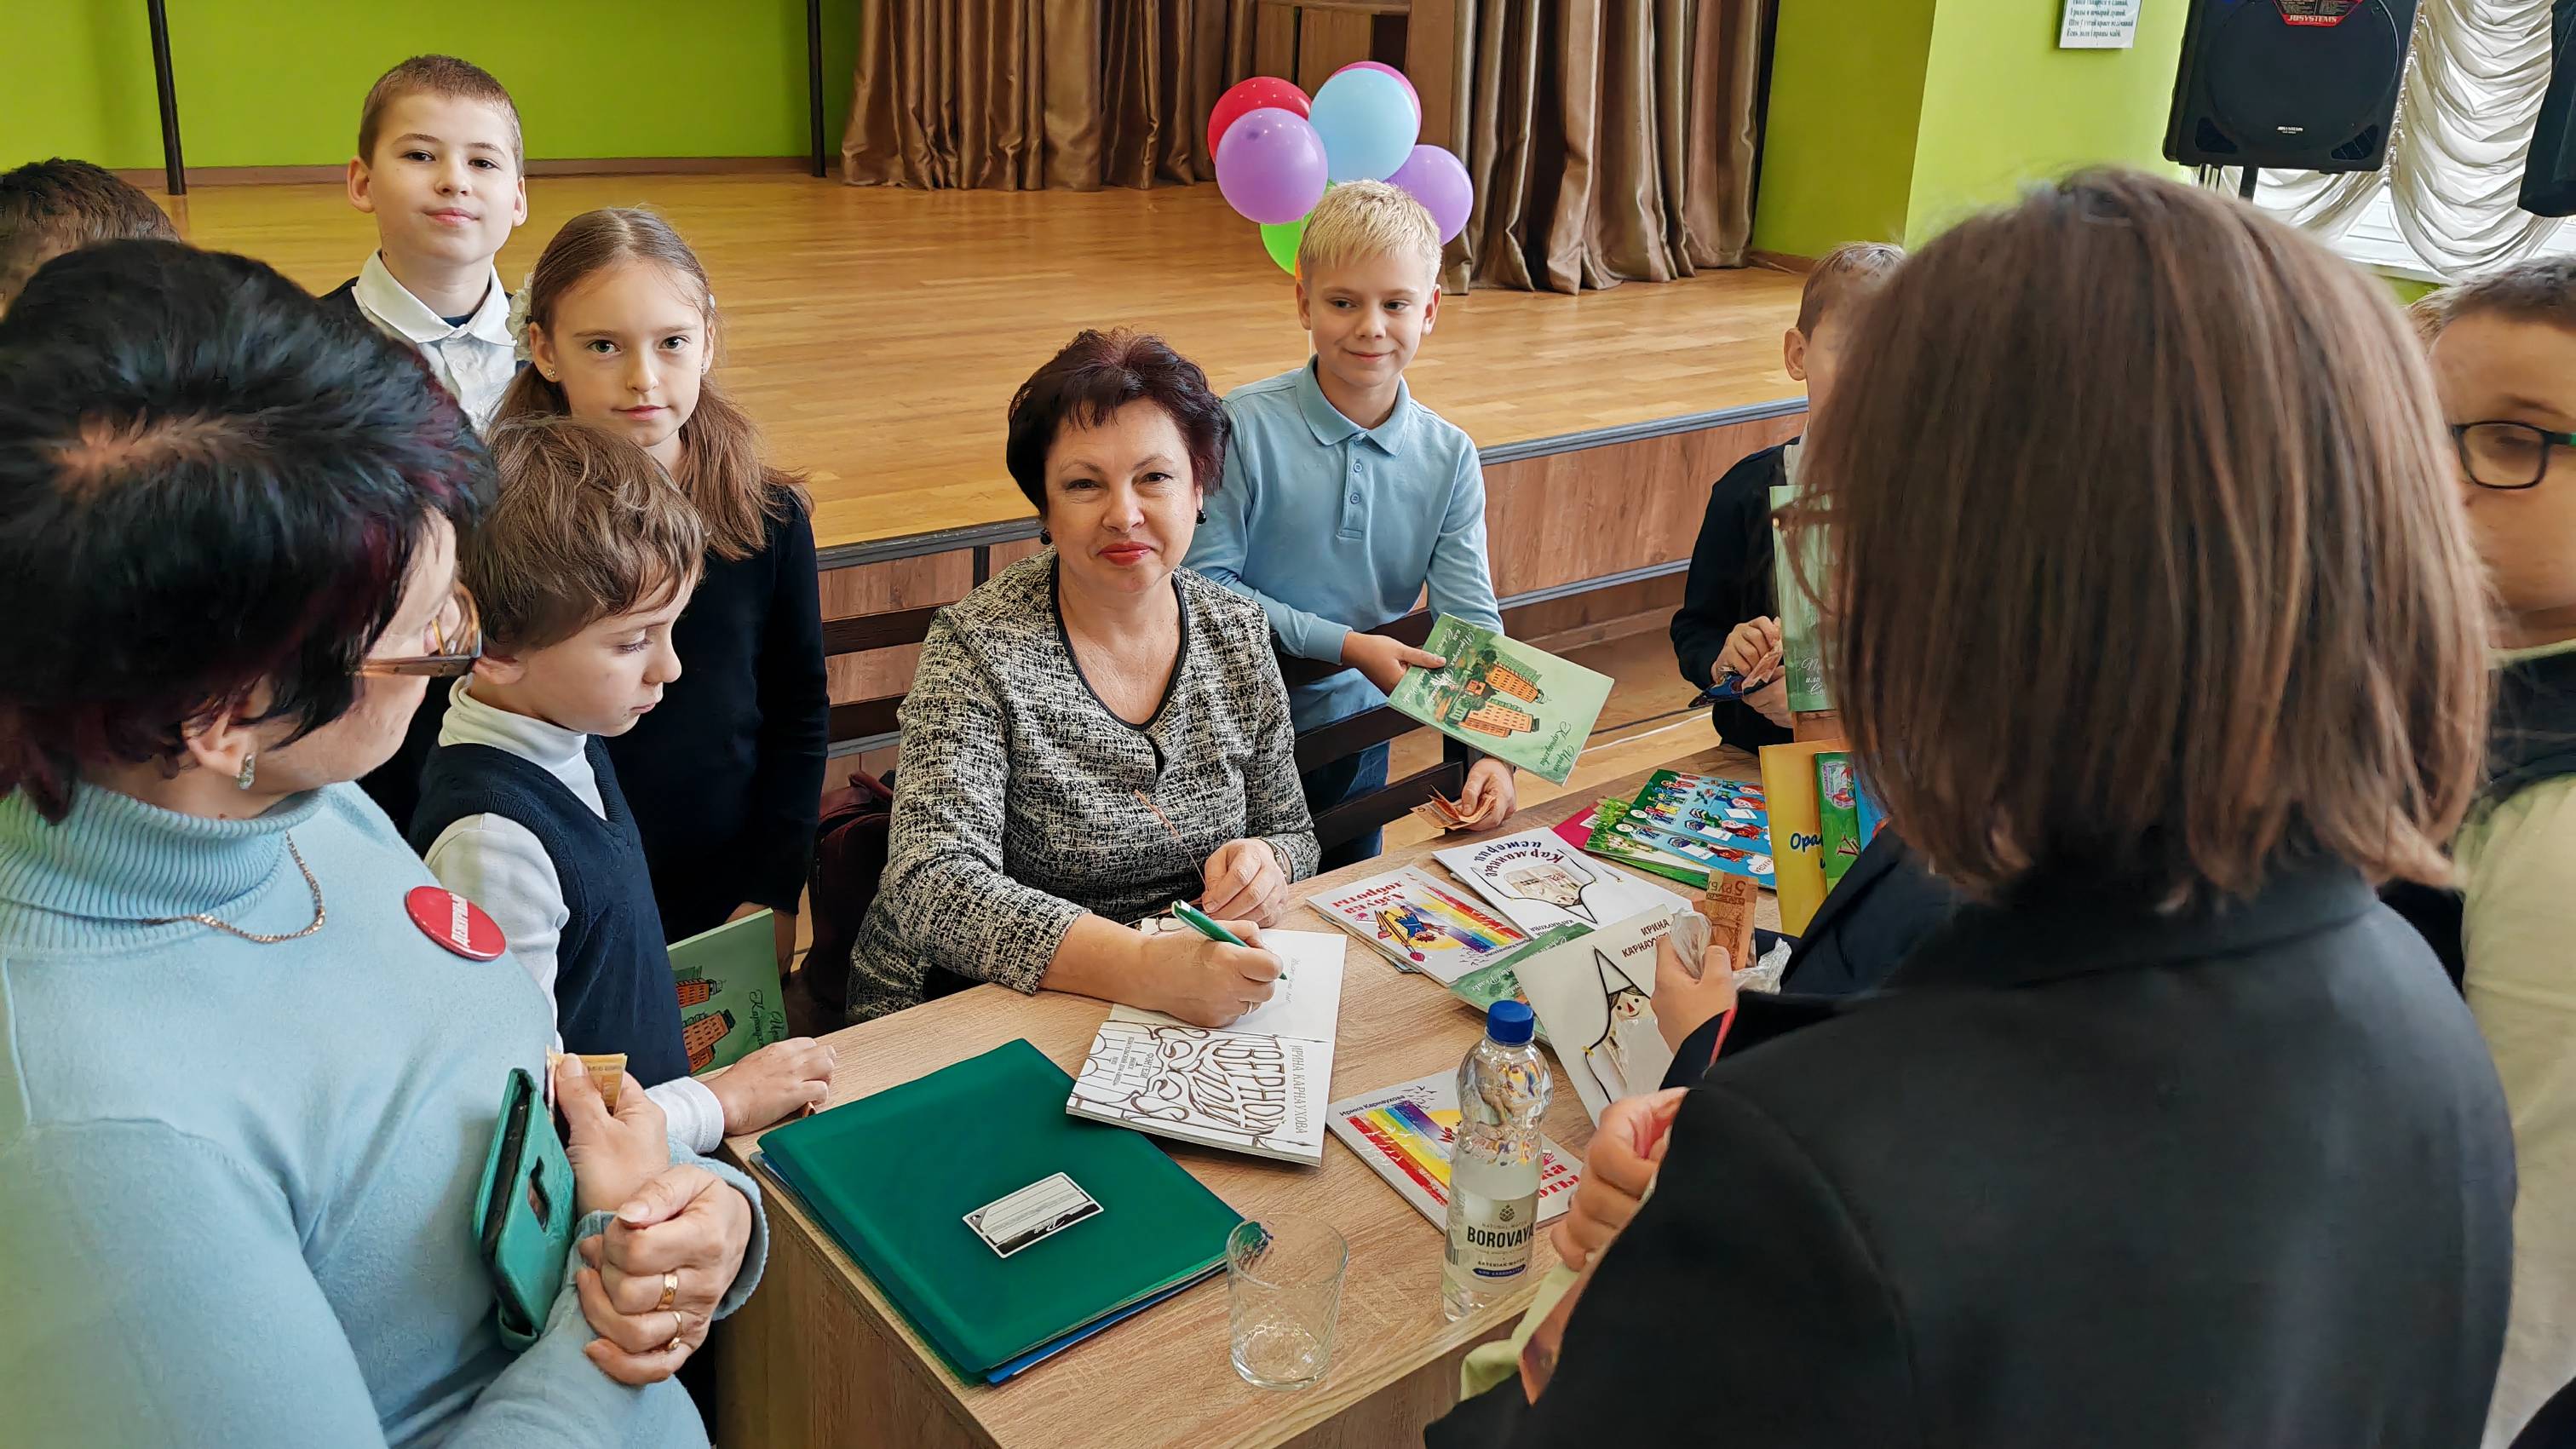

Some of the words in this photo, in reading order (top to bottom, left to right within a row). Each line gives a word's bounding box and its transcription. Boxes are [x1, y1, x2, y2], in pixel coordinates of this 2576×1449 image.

[1539, 721, 1572, 766] Карнаухова
[1552, 745, 1575, 772] Ирина
[1474, 841, 1542, 862] истории
[1485, 848, 1564, 877] Карманные
[1331, 880, 1405, 908] доброты
[1735, 881, 1746, 896] 5
[1343, 891, 1406, 914] Азбука
[1640, 918, 1670, 936] ИРИНА
[1621, 932, 1671, 957] КАРНАУ
[1140, 1053, 1154, 1078] ФЭНТЕЗИ
[1290, 1044, 1304, 1071] ИРИНА
[1293, 1073, 1308, 1134] КАРНАУХОВА
[1339, 1106, 1364, 1117] Ирина
[1363, 1095, 1406, 1109] Карнаухова
[1467, 1222, 1534, 1249] BOROVAYA
